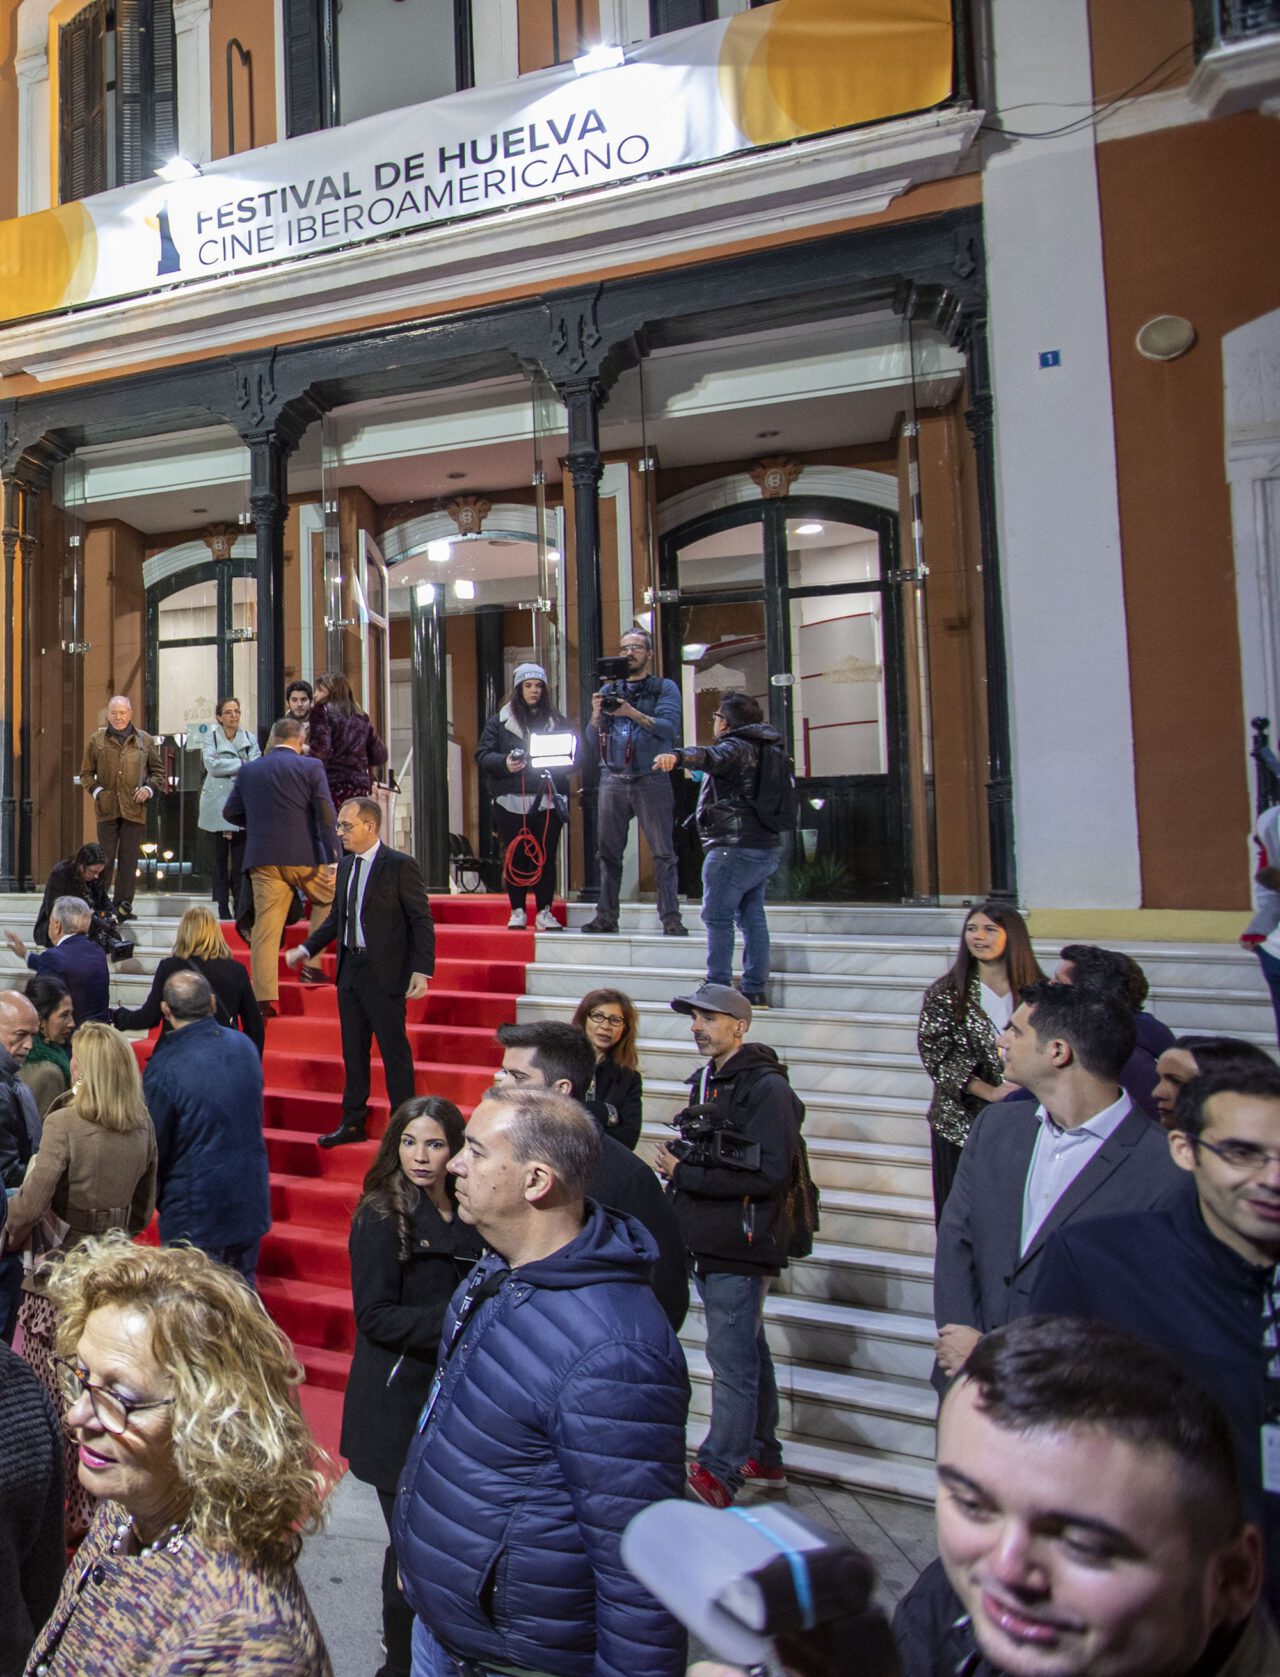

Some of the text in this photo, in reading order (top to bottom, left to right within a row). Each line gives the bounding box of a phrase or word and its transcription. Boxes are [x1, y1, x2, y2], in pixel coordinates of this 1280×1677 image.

[197, 109, 607, 234] FESTIVAL DE HUELVA
[198, 135, 650, 266] CINE IBEROAMERICANO
